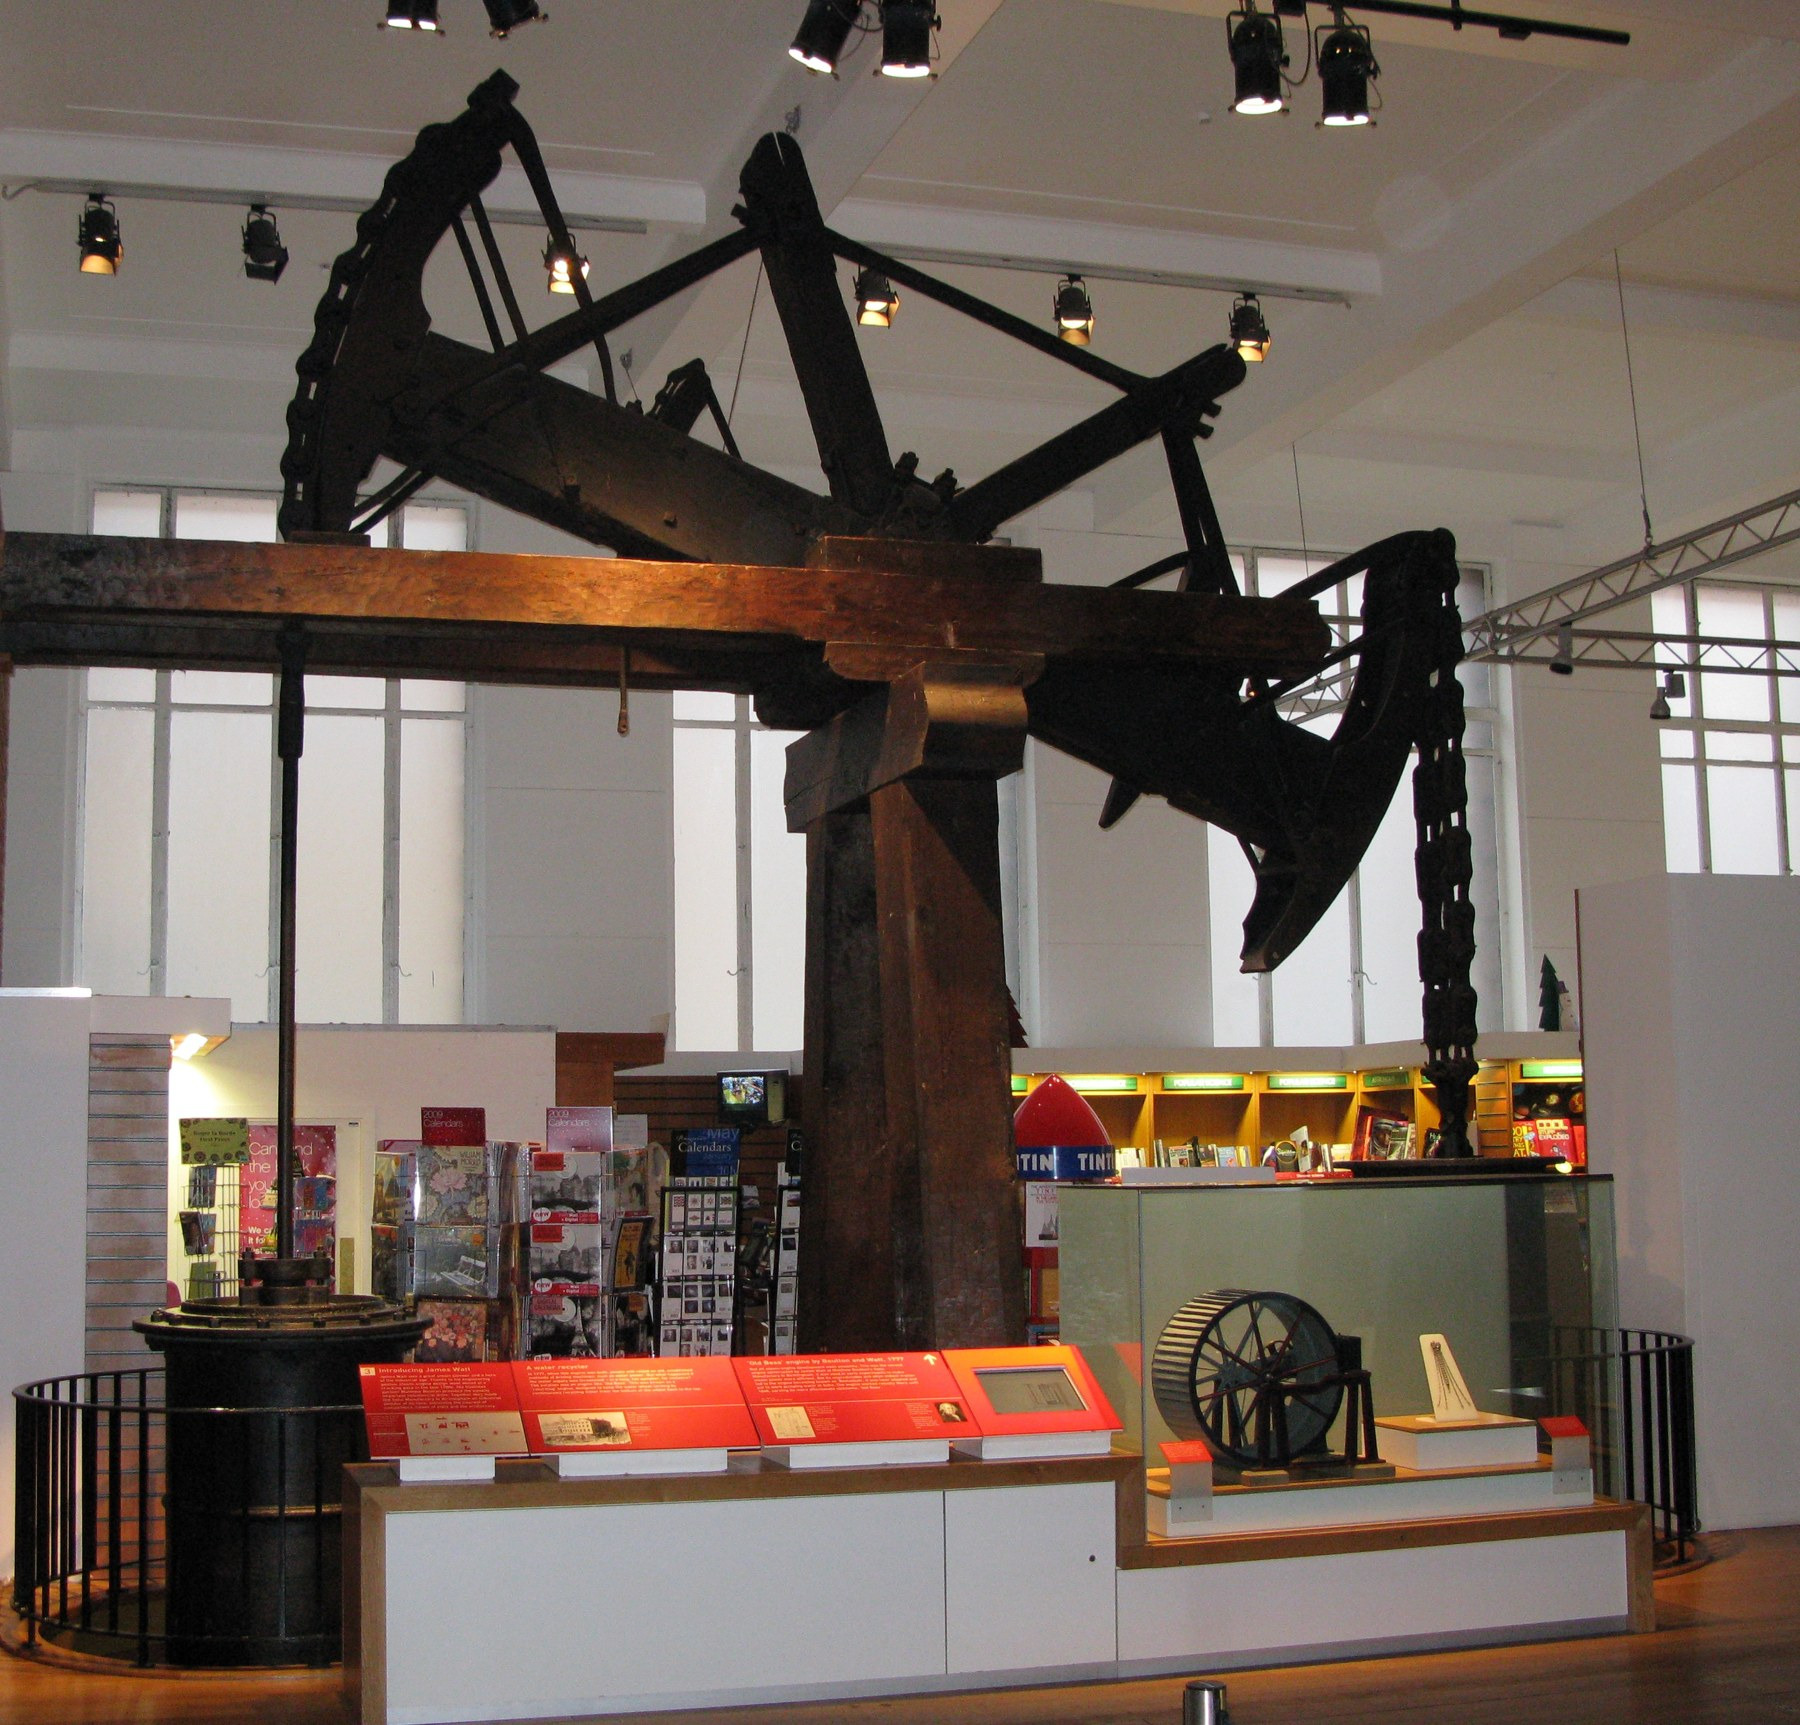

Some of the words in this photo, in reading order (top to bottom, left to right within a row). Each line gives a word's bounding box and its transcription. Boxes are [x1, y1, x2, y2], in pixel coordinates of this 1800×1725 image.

[424, 1110, 444, 1119] 2009
[548, 1110, 569, 1118] 2009
[424, 1119, 464, 1128] Calendars
[548, 1118, 590, 1127] Calendars
[678, 1141, 732, 1152] Calendars
[249, 1162, 270, 1174] the
[248, 1226, 261, 1234] We
[379, 1367, 424, 1375] Introducing
